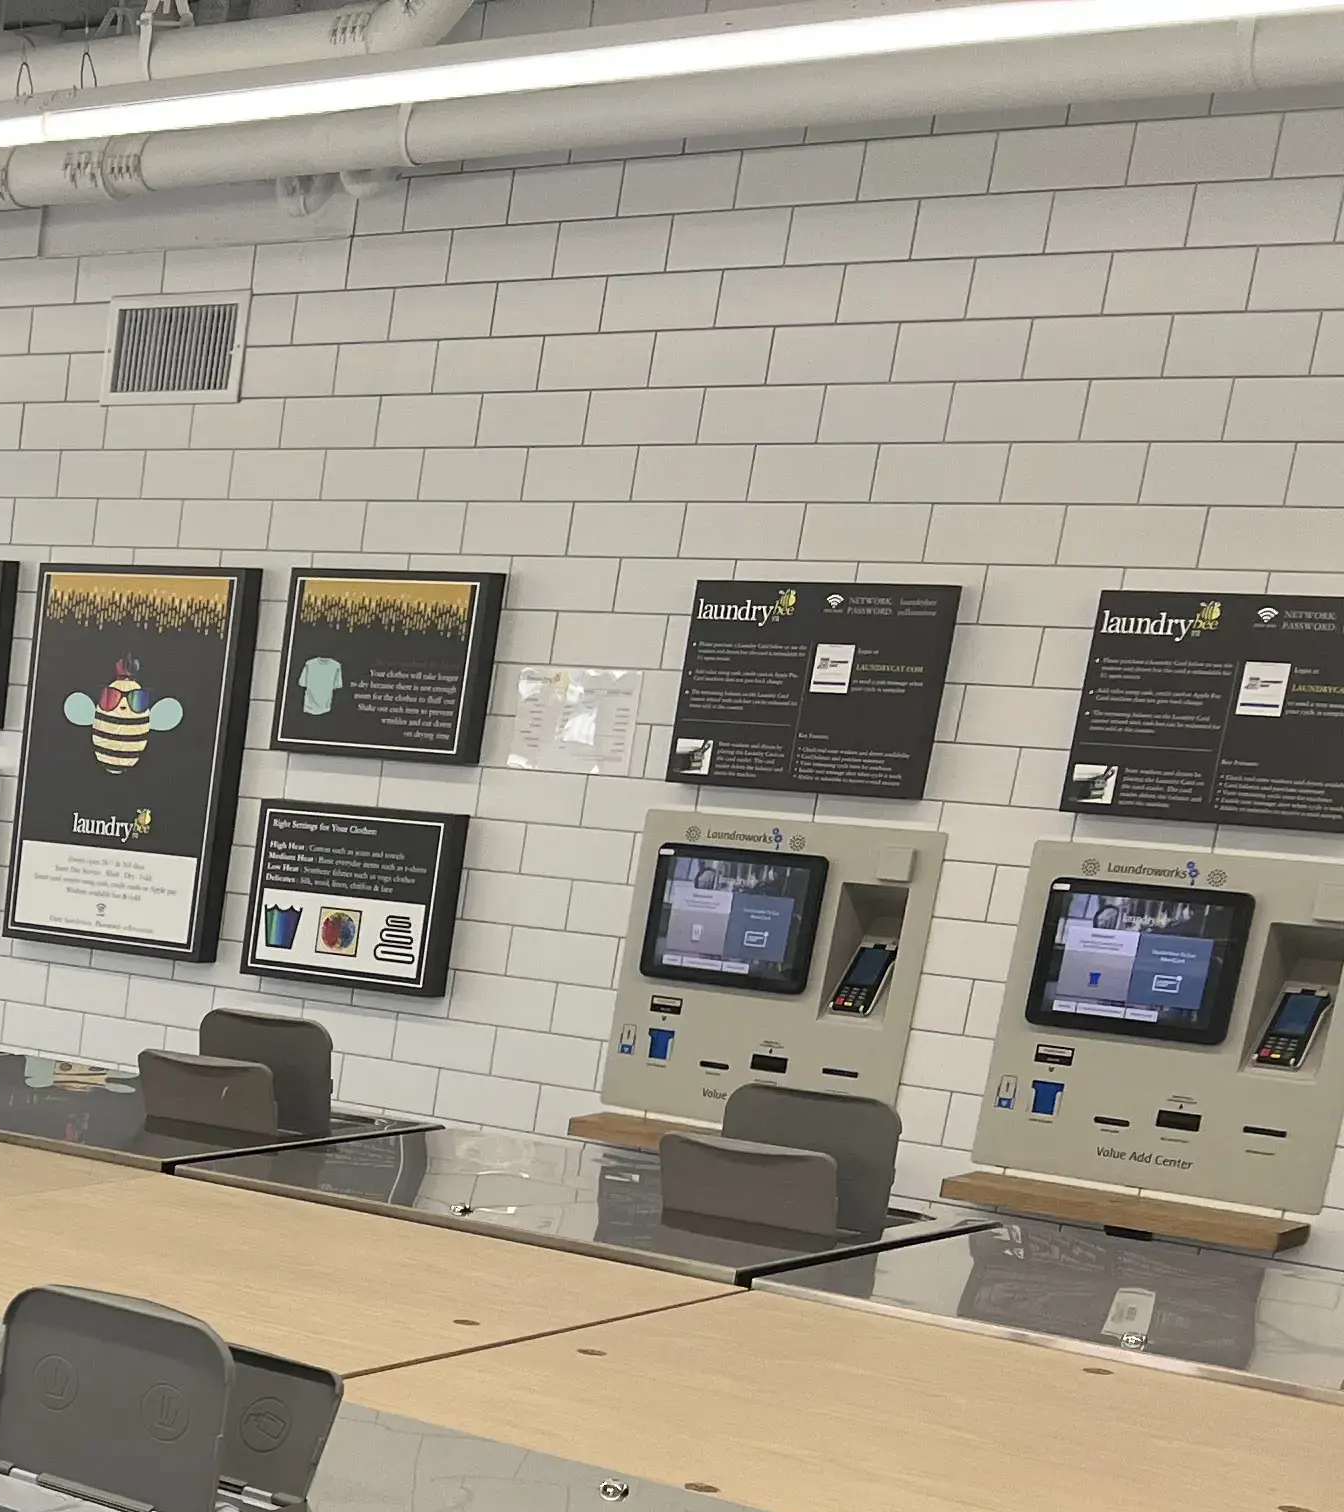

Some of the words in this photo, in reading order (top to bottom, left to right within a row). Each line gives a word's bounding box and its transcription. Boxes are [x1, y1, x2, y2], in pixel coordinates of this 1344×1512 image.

[697, 598, 795, 626] laundrybee
[1100, 609, 1219, 642] laundrybee
[273, 819, 291, 830] Right
[292, 820, 318, 831] Settings
[332, 823, 347, 833] Your
[706, 828, 773, 845] Laundroworks
[1107, 862, 1188, 879] Laundroworks
[702, 1086, 728, 1101] Value
[1096, 1146, 1126, 1160] Value
[1128, 1149, 1152, 1164] Add
[1154, 1153, 1194, 1170] Center
